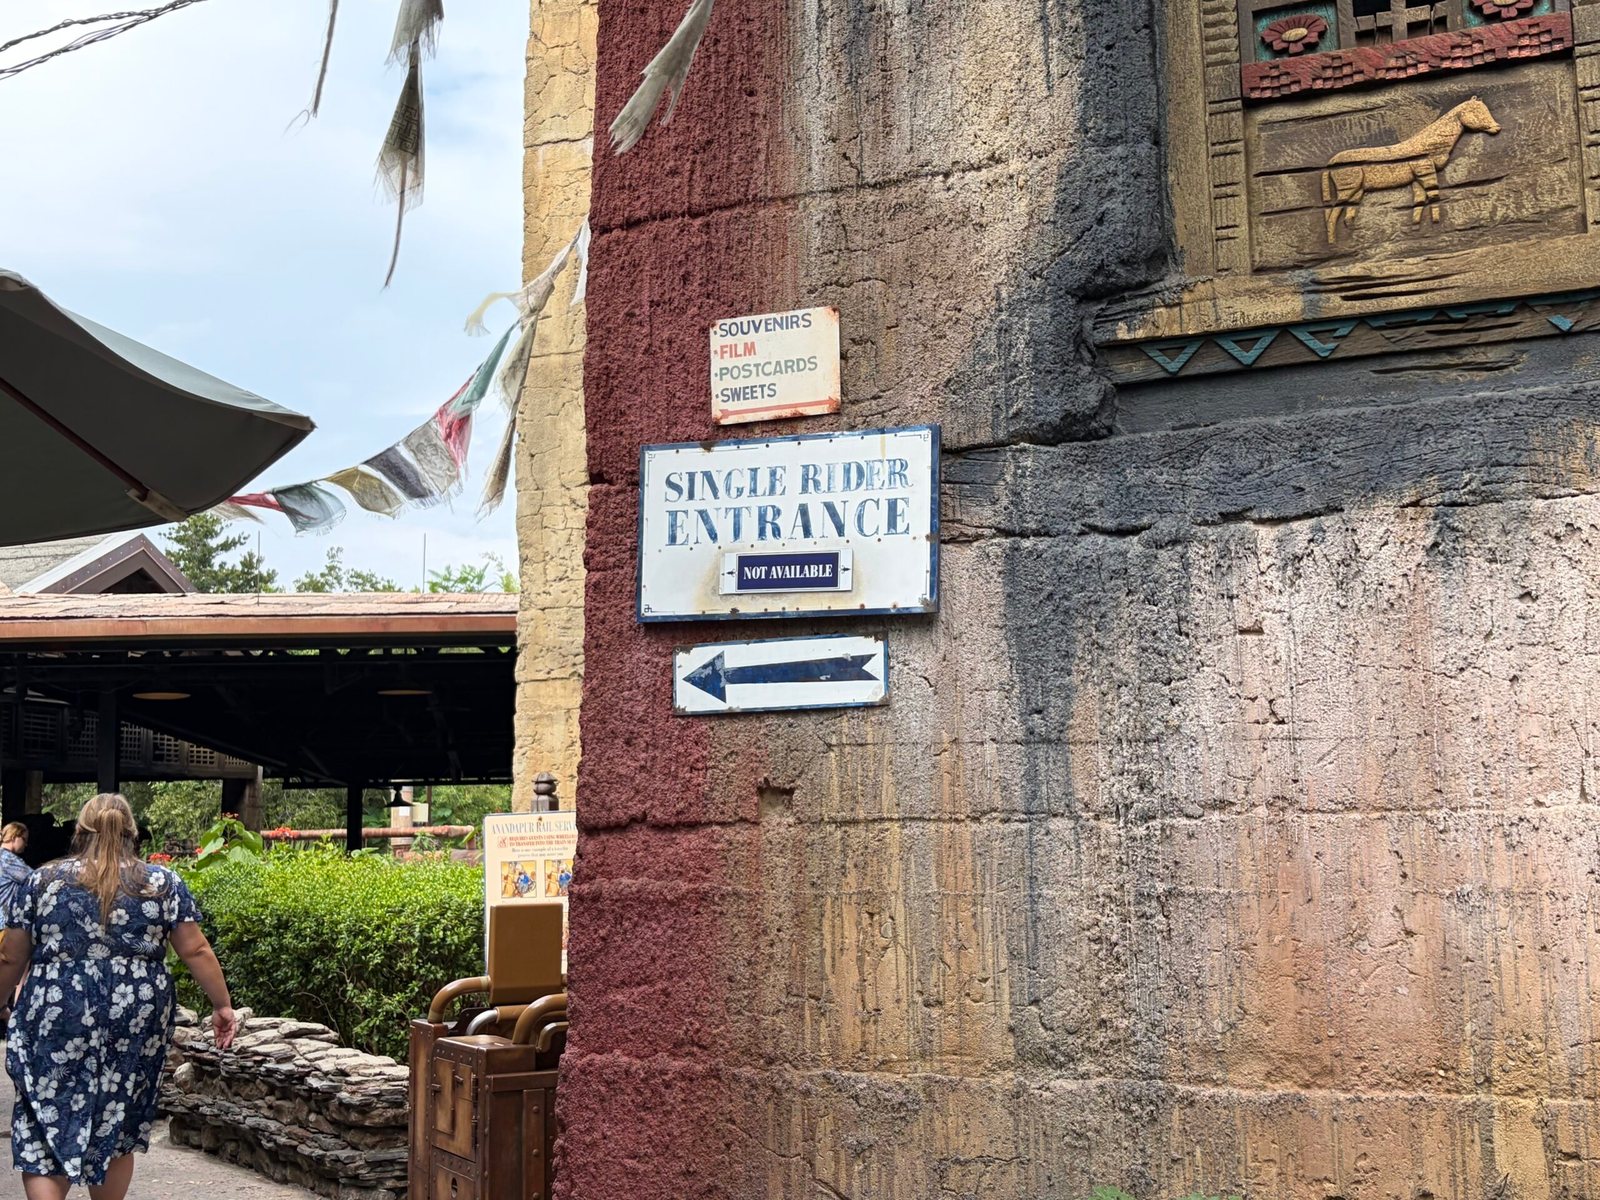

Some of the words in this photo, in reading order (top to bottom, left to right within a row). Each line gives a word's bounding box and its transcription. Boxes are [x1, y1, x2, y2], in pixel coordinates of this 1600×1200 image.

[719, 312, 812, 338] SOUVENIRS
[719, 341, 757, 360] FILM
[719, 355, 818, 382] POSTCARDS
[720, 382, 777, 403] SWEETS
[664, 465, 787, 503] SINGLE
[798, 458, 914, 496] RIDER
[664, 496, 911, 547] ENTRANCE
[743, 566, 768, 580] NOT
[769, 563, 833, 579] AVAILABLE
[492, 822, 534, 834] ANANDAPUR
[537, 821, 552, 833] RAIL
